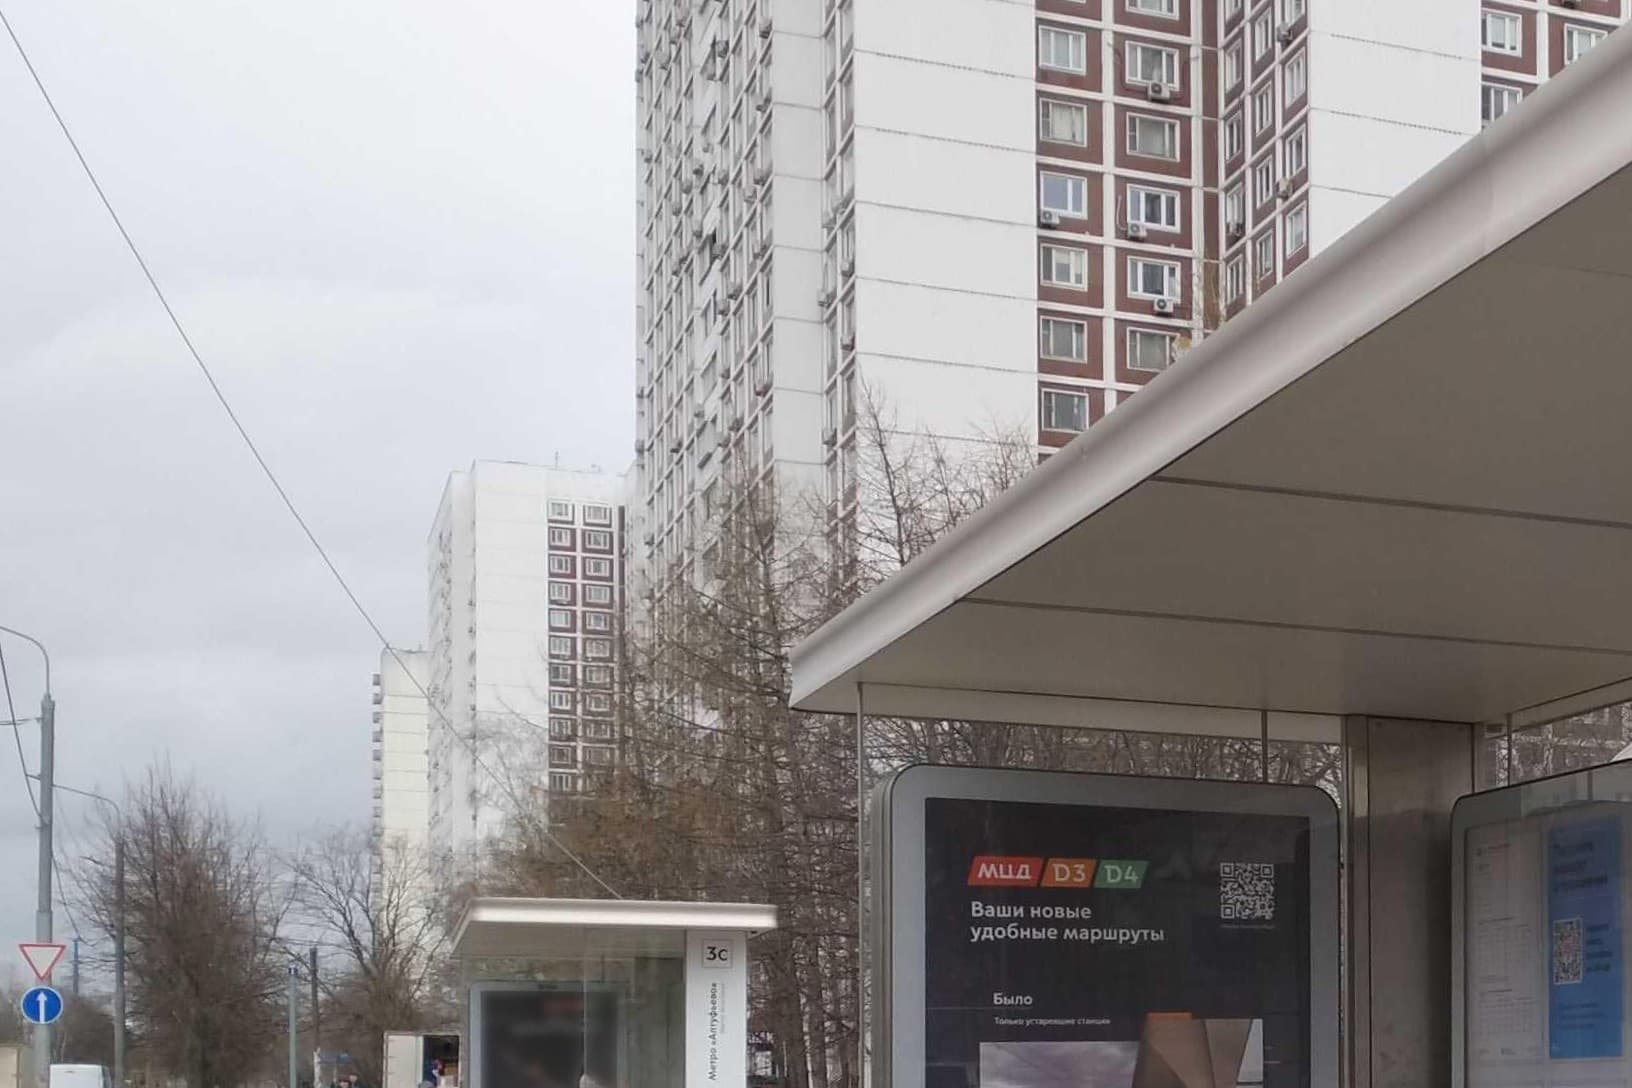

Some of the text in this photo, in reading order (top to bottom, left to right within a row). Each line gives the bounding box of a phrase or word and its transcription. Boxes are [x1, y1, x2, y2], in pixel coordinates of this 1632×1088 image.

[977, 862, 1140, 883] МЦД D3 D4
[970, 901, 1092, 919] Ваши новые
[970, 923, 1165, 945] удобные маршруты
[992, 992, 1034, 1006] Было
[708, 1047, 719, 1081] Метро
